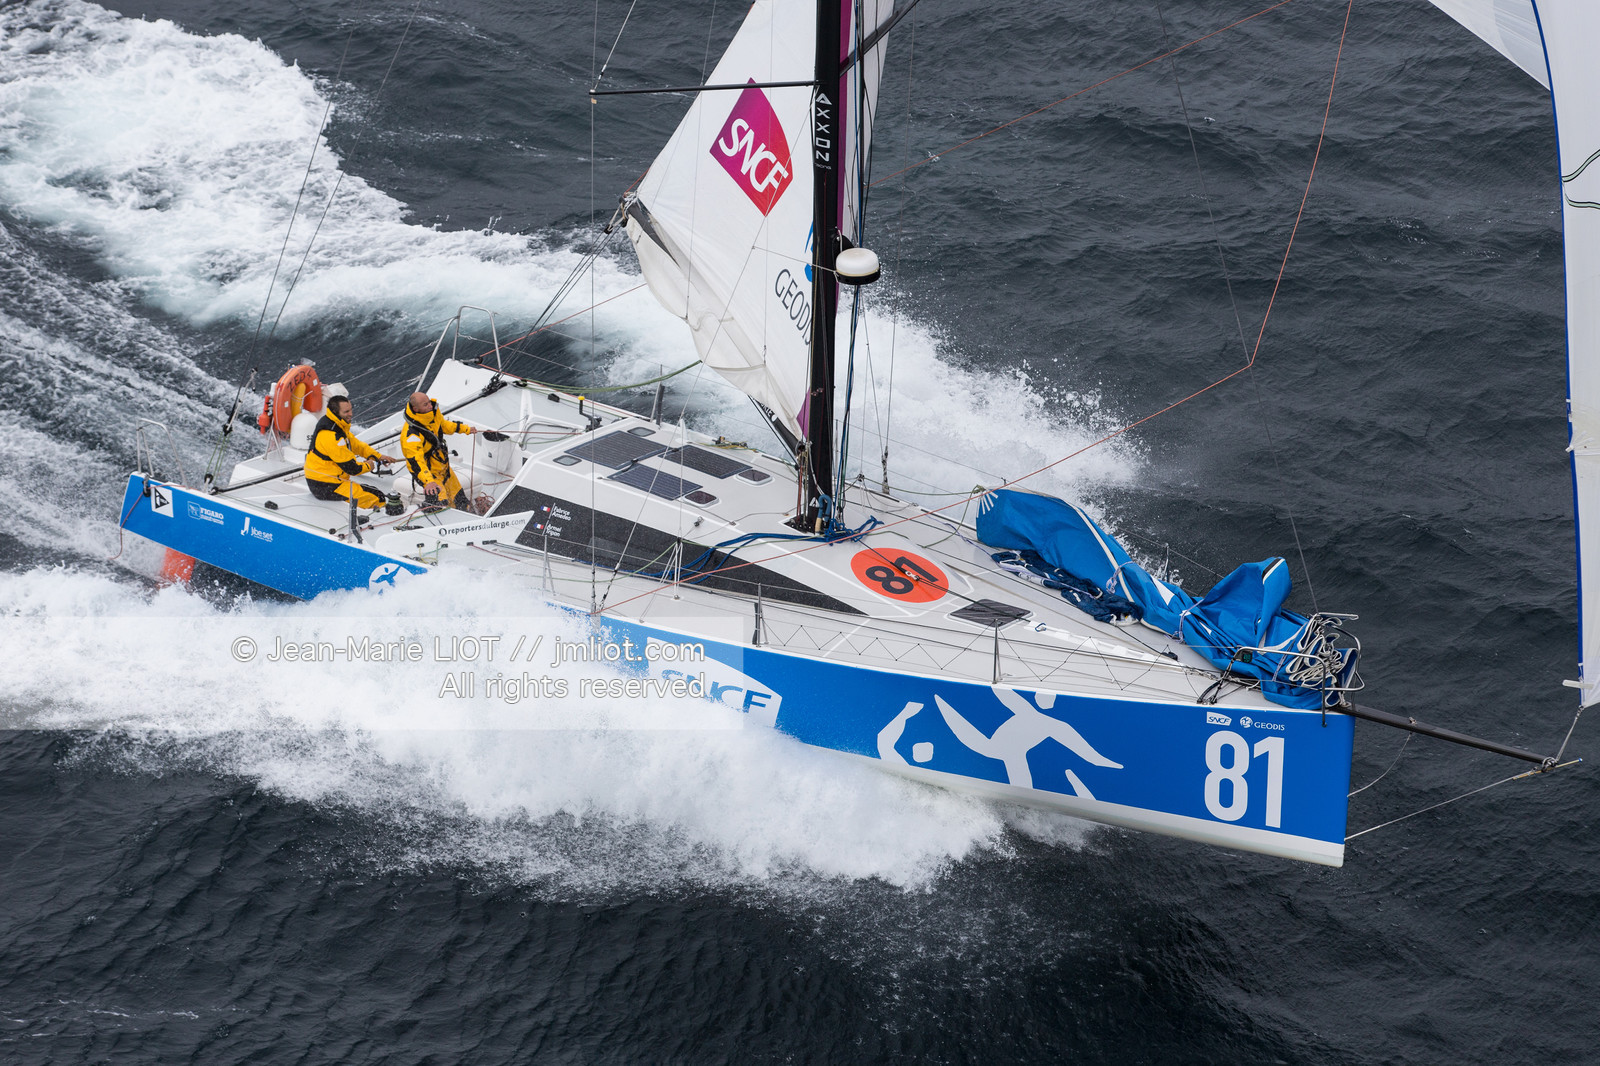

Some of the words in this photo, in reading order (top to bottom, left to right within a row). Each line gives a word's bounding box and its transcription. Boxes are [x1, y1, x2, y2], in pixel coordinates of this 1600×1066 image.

[718, 118, 789, 193] SNCF
[815, 92, 833, 162] AXXON
[865, 556, 939, 595] 81
[1208, 716, 1231, 724] SNCF
[1254, 721, 1285, 731] GEODIS
[1204, 730, 1285, 829] 81
